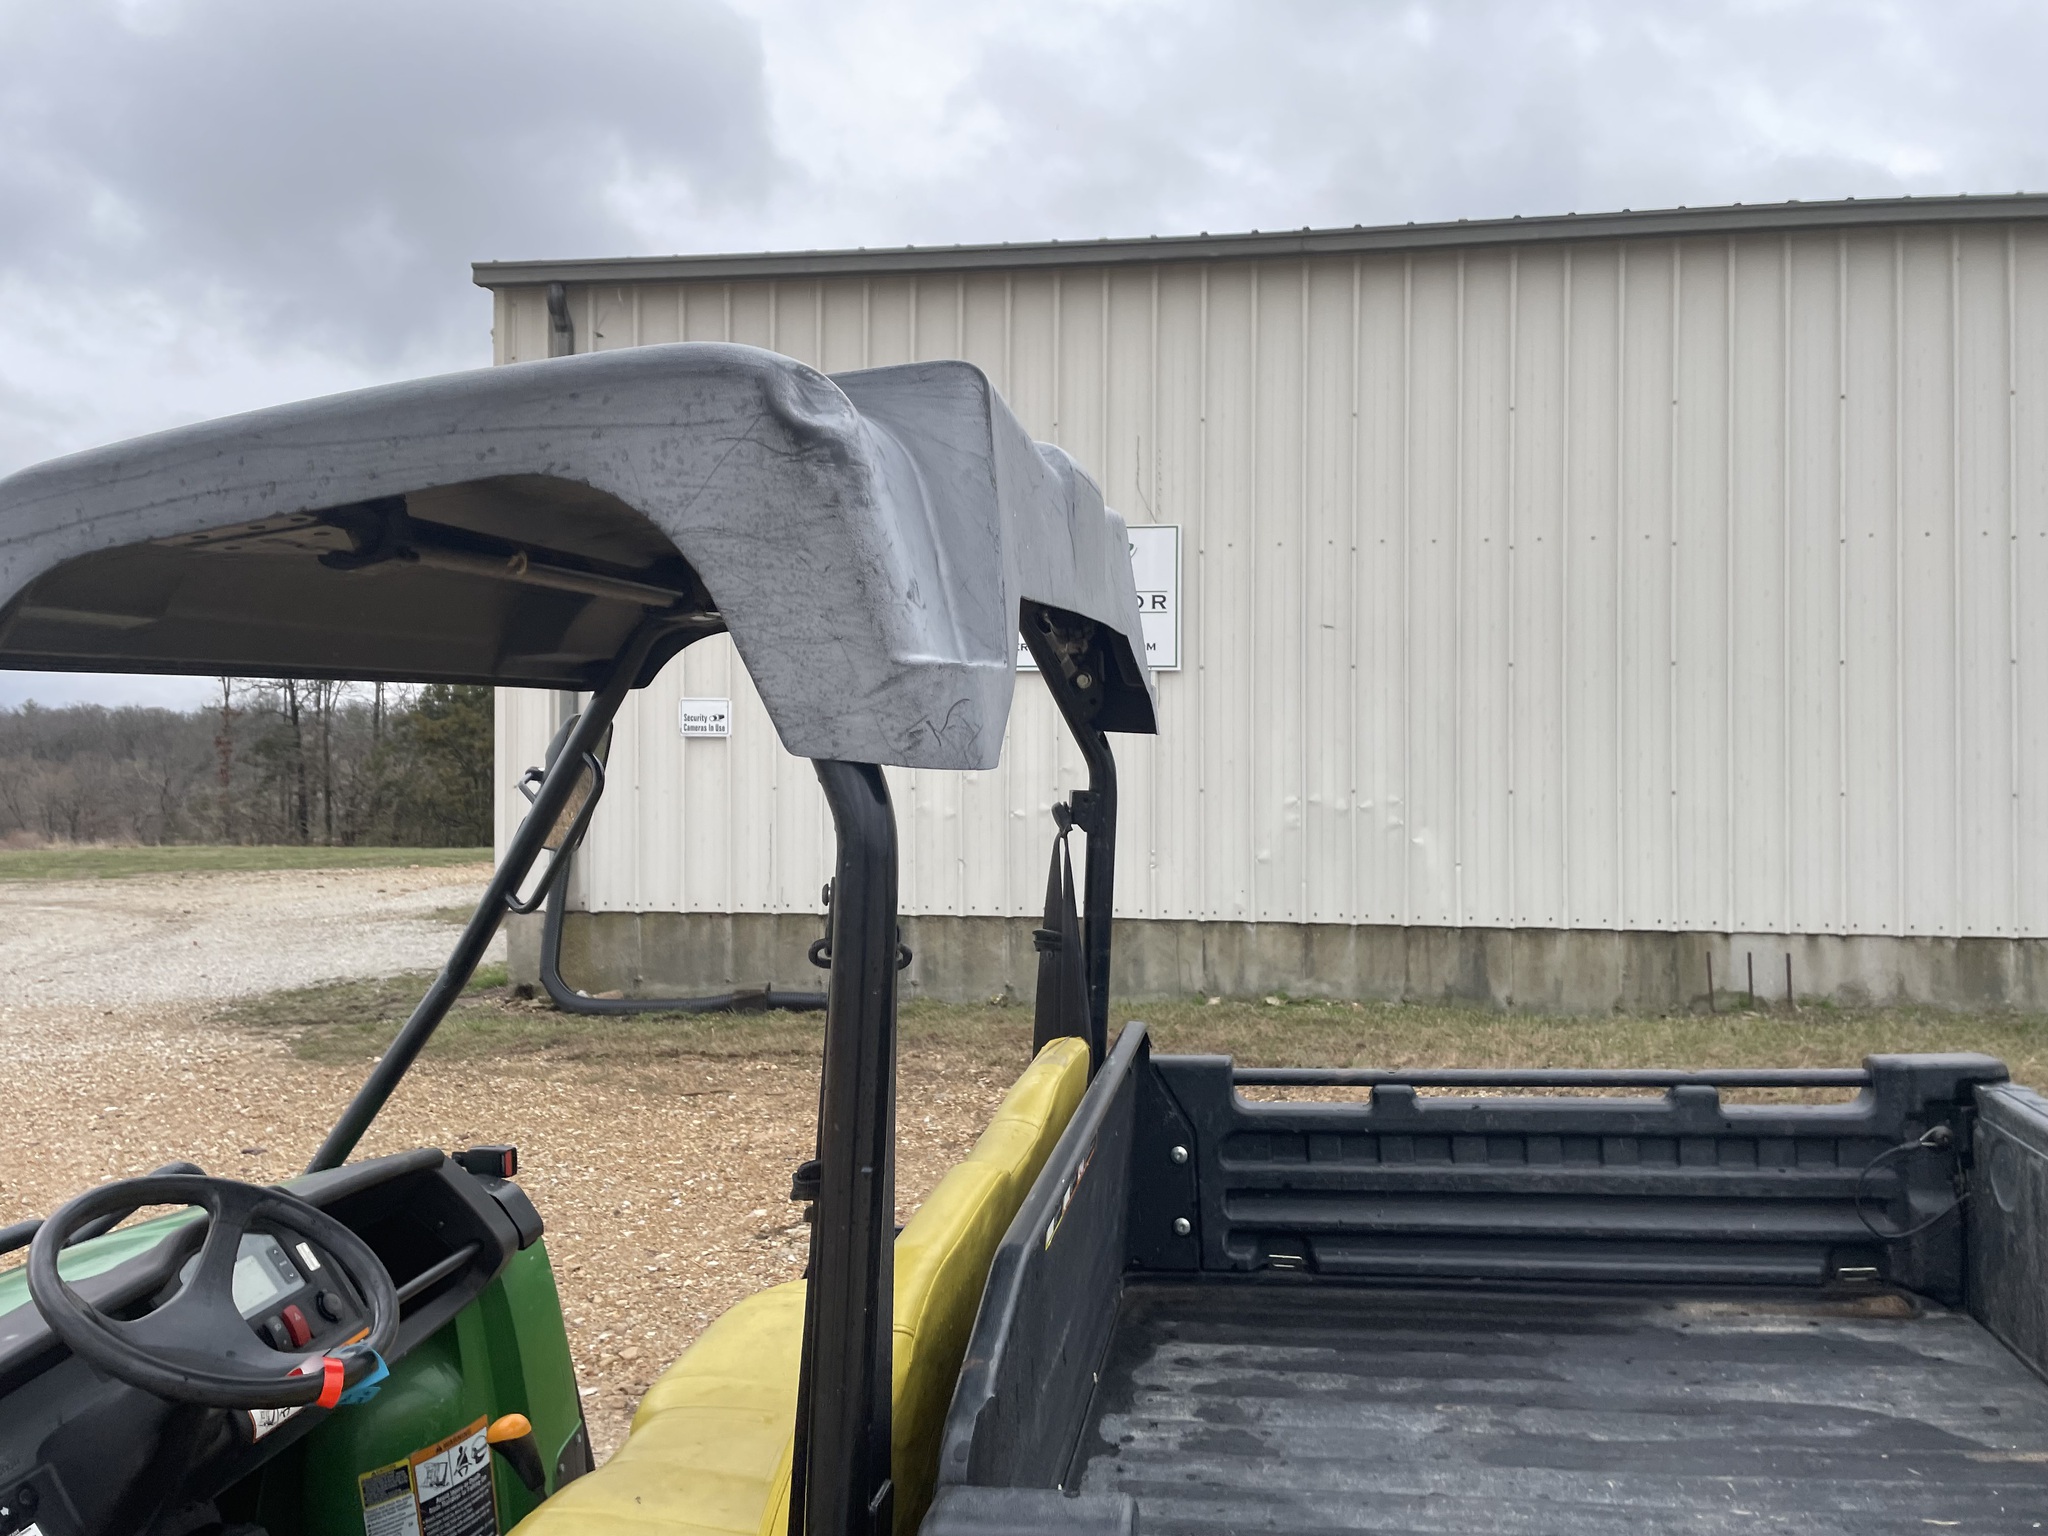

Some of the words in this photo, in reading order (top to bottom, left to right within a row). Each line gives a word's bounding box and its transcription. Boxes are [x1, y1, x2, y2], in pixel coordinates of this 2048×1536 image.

[683, 713, 708, 723] Security
[683, 723, 707, 732] Cameras
[708, 723, 714, 732] In
[715, 723, 725, 732] Use
